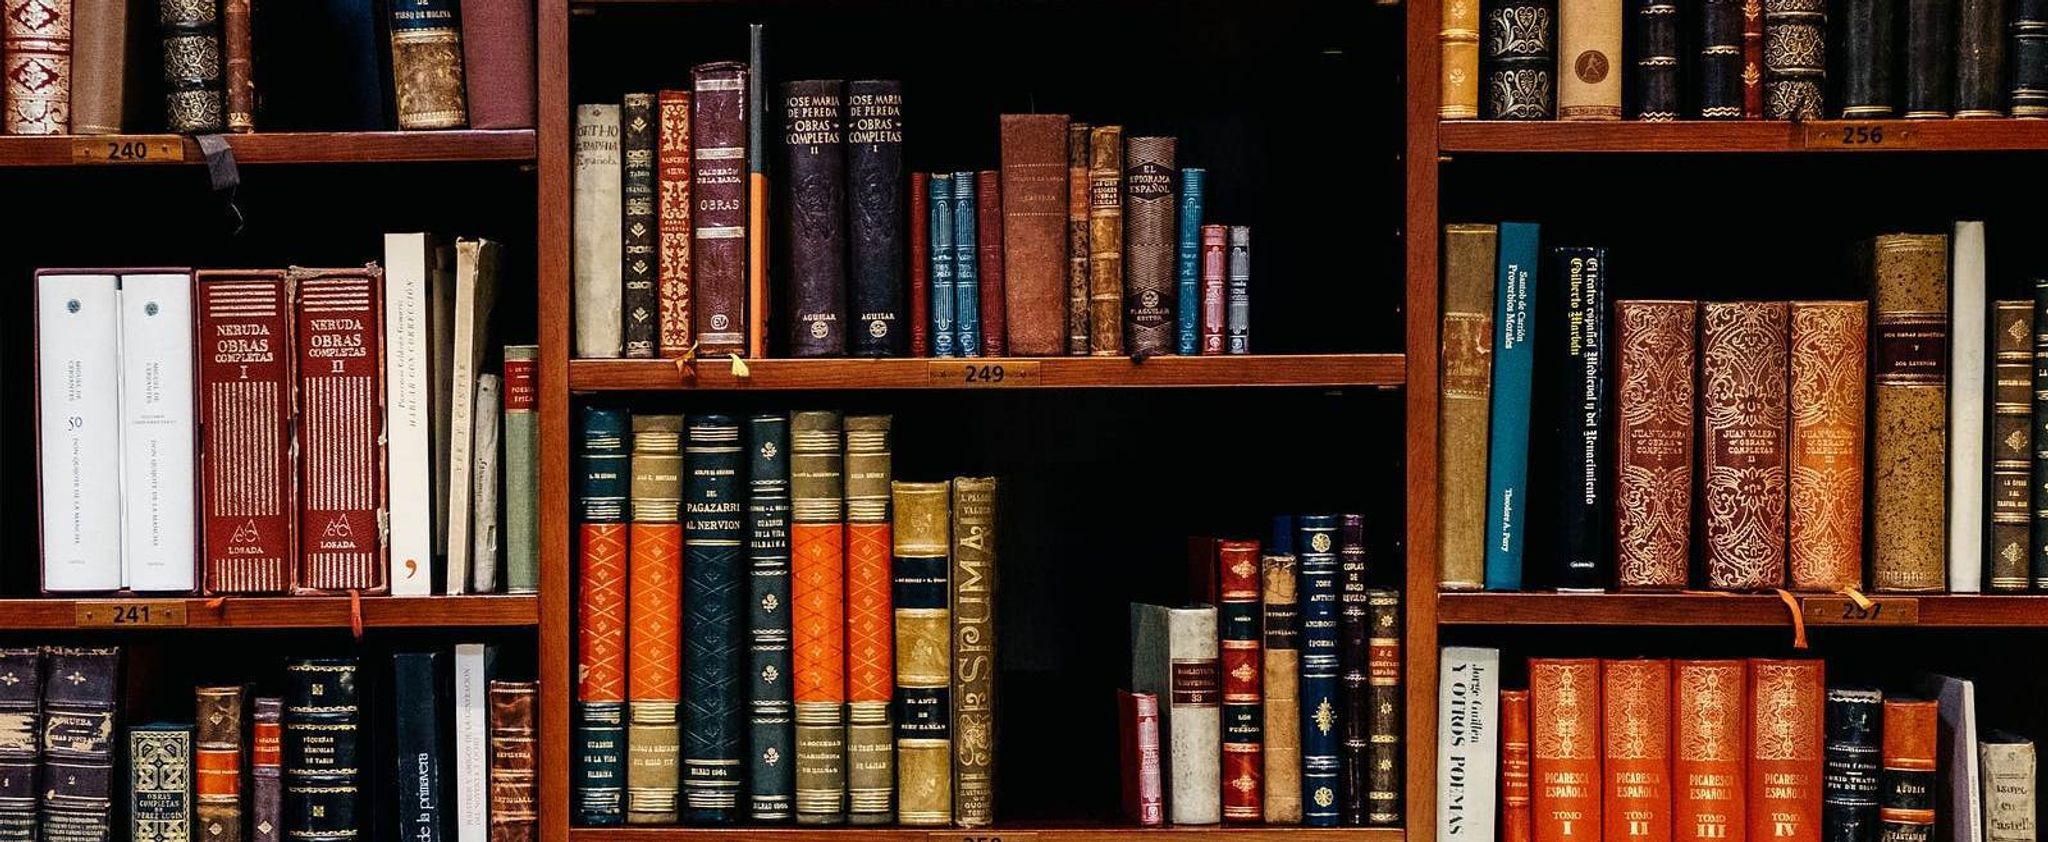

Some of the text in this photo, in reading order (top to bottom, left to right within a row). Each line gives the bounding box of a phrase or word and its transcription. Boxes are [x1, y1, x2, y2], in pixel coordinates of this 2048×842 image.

[786, 96, 840, 108] JOSE MARIA
[848, 95, 902, 107] JOSE MARIA
[788, 107, 838, 118] DE PEREDA
[850, 106, 900, 117] DE PEREDA
[795, 120, 830, 132] OBRAS
[857, 118, 893, 130] OBRAS
[786, 132, 840, 144] COMPLETAS
[848, 130, 902, 144] COMPLETAS
[1842, 126, 1883, 144] 256
[108, 142, 146, 159] 240
[1144, 165, 1156, 174] EL
[696, 176, 741, 184] DE LA BARCA
[1129, 174, 1170, 183] EPIGRAMA
[1129, 182, 1170, 194] ESPAÑOL
[700, 198, 740, 211] OBRAS
[1585, 258, 1598, 272] El
[1570, 258, 1582, 308] Edilberto
[1586, 274, 1598, 305] teatro
[1504, 264, 1518, 350] Proverbios Morales
[1516, 271, 1528, 342] Santob de Carrión
[803, 314, 836, 322] AGUILAR
[862, 312, 896, 321] AGUILAR
[216, 324, 270, 336] NERUDA
[310, 320, 363, 331] NERUDA
[1583, 308, 1598, 348] español
[217, 340, 269, 353] OBRAS
[310, 334, 362, 347] OBRAS
[214, 352, 274, 364] COMPLETAS
[308, 347, 366, 358] COMPLETAS
[238, 365, 248, 379] I
[331, 360, 345, 373] II
[407, 356, 416, 378] CON
[966, 365, 1004, 382] 249
[1583, 350, 1598, 400] Medieval
[408, 383, 417, 427] HABLAR
[1586, 411, 1598, 427] del
[1631, 430, 1686, 438] JUAN VALERA
[1722, 430, 1777, 438] JUAN VALERA
[1801, 430, 1822, 438] JUAN
[1636, 446, 1682, 455] COMPLETAS
[1728, 446, 1774, 454] COMPLETAS
[1583, 428, 1598, 505] Renacimiento
[686, 502, 740, 512] PAGAZARRI
[686, 520, 740, 530] AL NERVION
[1500, 488, 1512, 552] Theodore A. Perry
[762, 530, 770, 538] LA
[320, 540, 356, 548] LOSADA
[228, 546, 264, 555] LOSADA
[1343, 562, 1364, 571] COPLAS
[1350, 572, 1358, 581] DE
[113, 606, 150, 623] 241
[1468, 664, 1484, 744] Jorge Guillén
[1448, 664, 1467, 834] Y OTROS POEMAS
[691, 768, 710, 776] BILBAO
[1545, 772, 1590, 784] PICARESCA
[1617, 772, 1660, 784] PICARESCA
[68, 776, 76, 785] 2
[1690, 774, 1733, 786] PICARESCA
[1764, 773, 1808, 786] PICARESCA
[416, 752, 435, 842] de la primavera
[1545, 786, 1588, 799] ESPAÑOLA
[1617, 787, 1659, 800] ESPAÑOLA
[1690, 788, 1732, 800] ESPAÑOLA
[1764, 788, 1806, 800] ESPAÑOLA
[1552, 812, 1582, 820] TOMO
[1624, 812, 1653, 820] TOMO
[1696, 814, 1726, 824] TOMO
[1772, 813, 1801, 822] TOMO
[1562, 822, 1572, 836] I
[1629, 822, 1648, 836] II
[1697, 824, 1726, 837] III
[1774, 822, 1796, 836] IV
